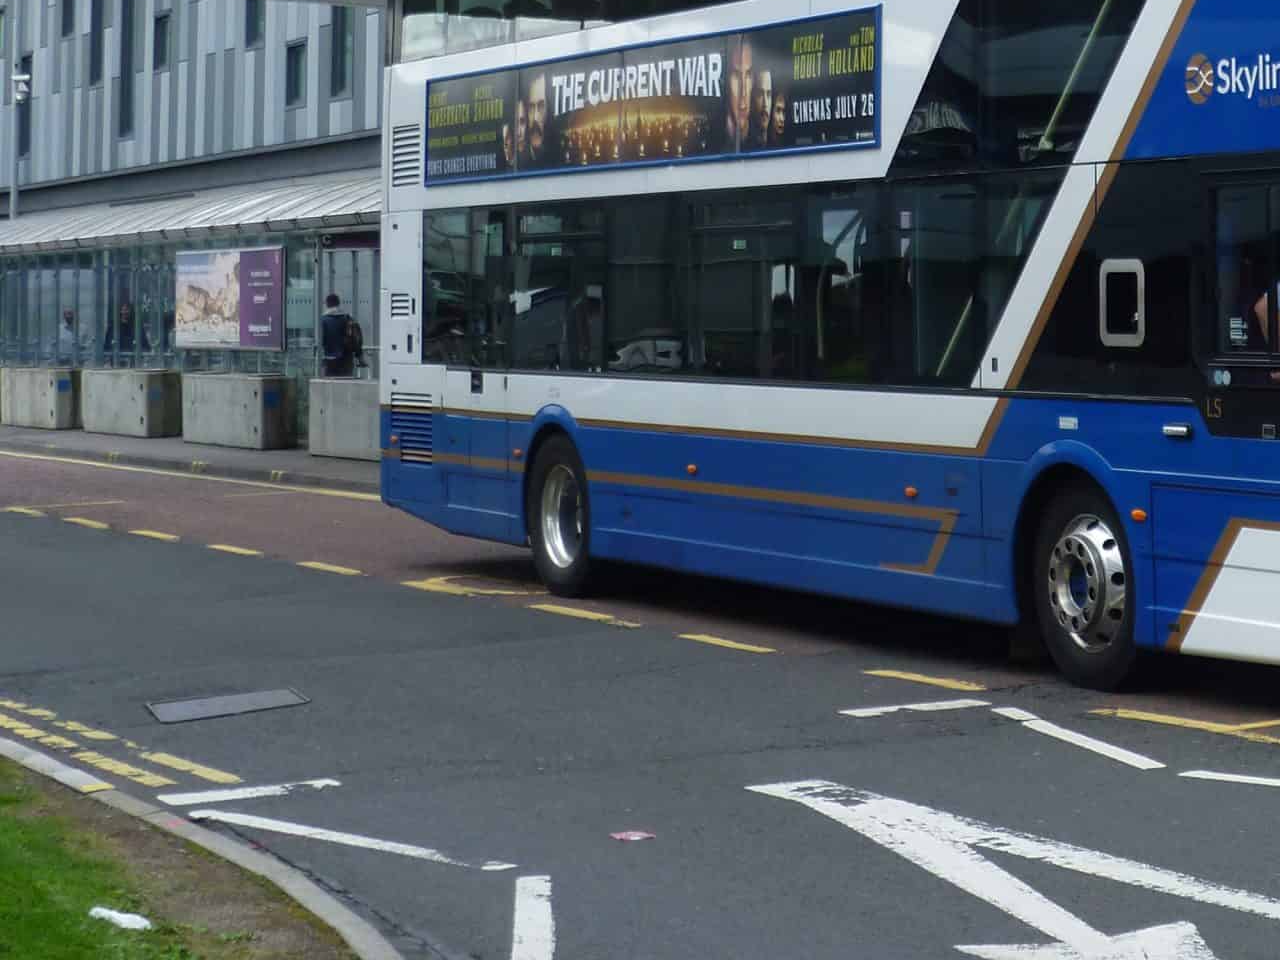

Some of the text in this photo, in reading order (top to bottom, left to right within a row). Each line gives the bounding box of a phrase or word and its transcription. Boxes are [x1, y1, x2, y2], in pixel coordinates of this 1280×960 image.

[794, 45, 875, 80] HOULT HOLLAND
[552, 71, 585, 117] THE
[587, 60, 675, 106] CURRENT
[678, 53, 723, 97] WAR
[793, 93, 874, 124] CINEMAS JULY 26
[1206, 398, 1222, 418] LS
